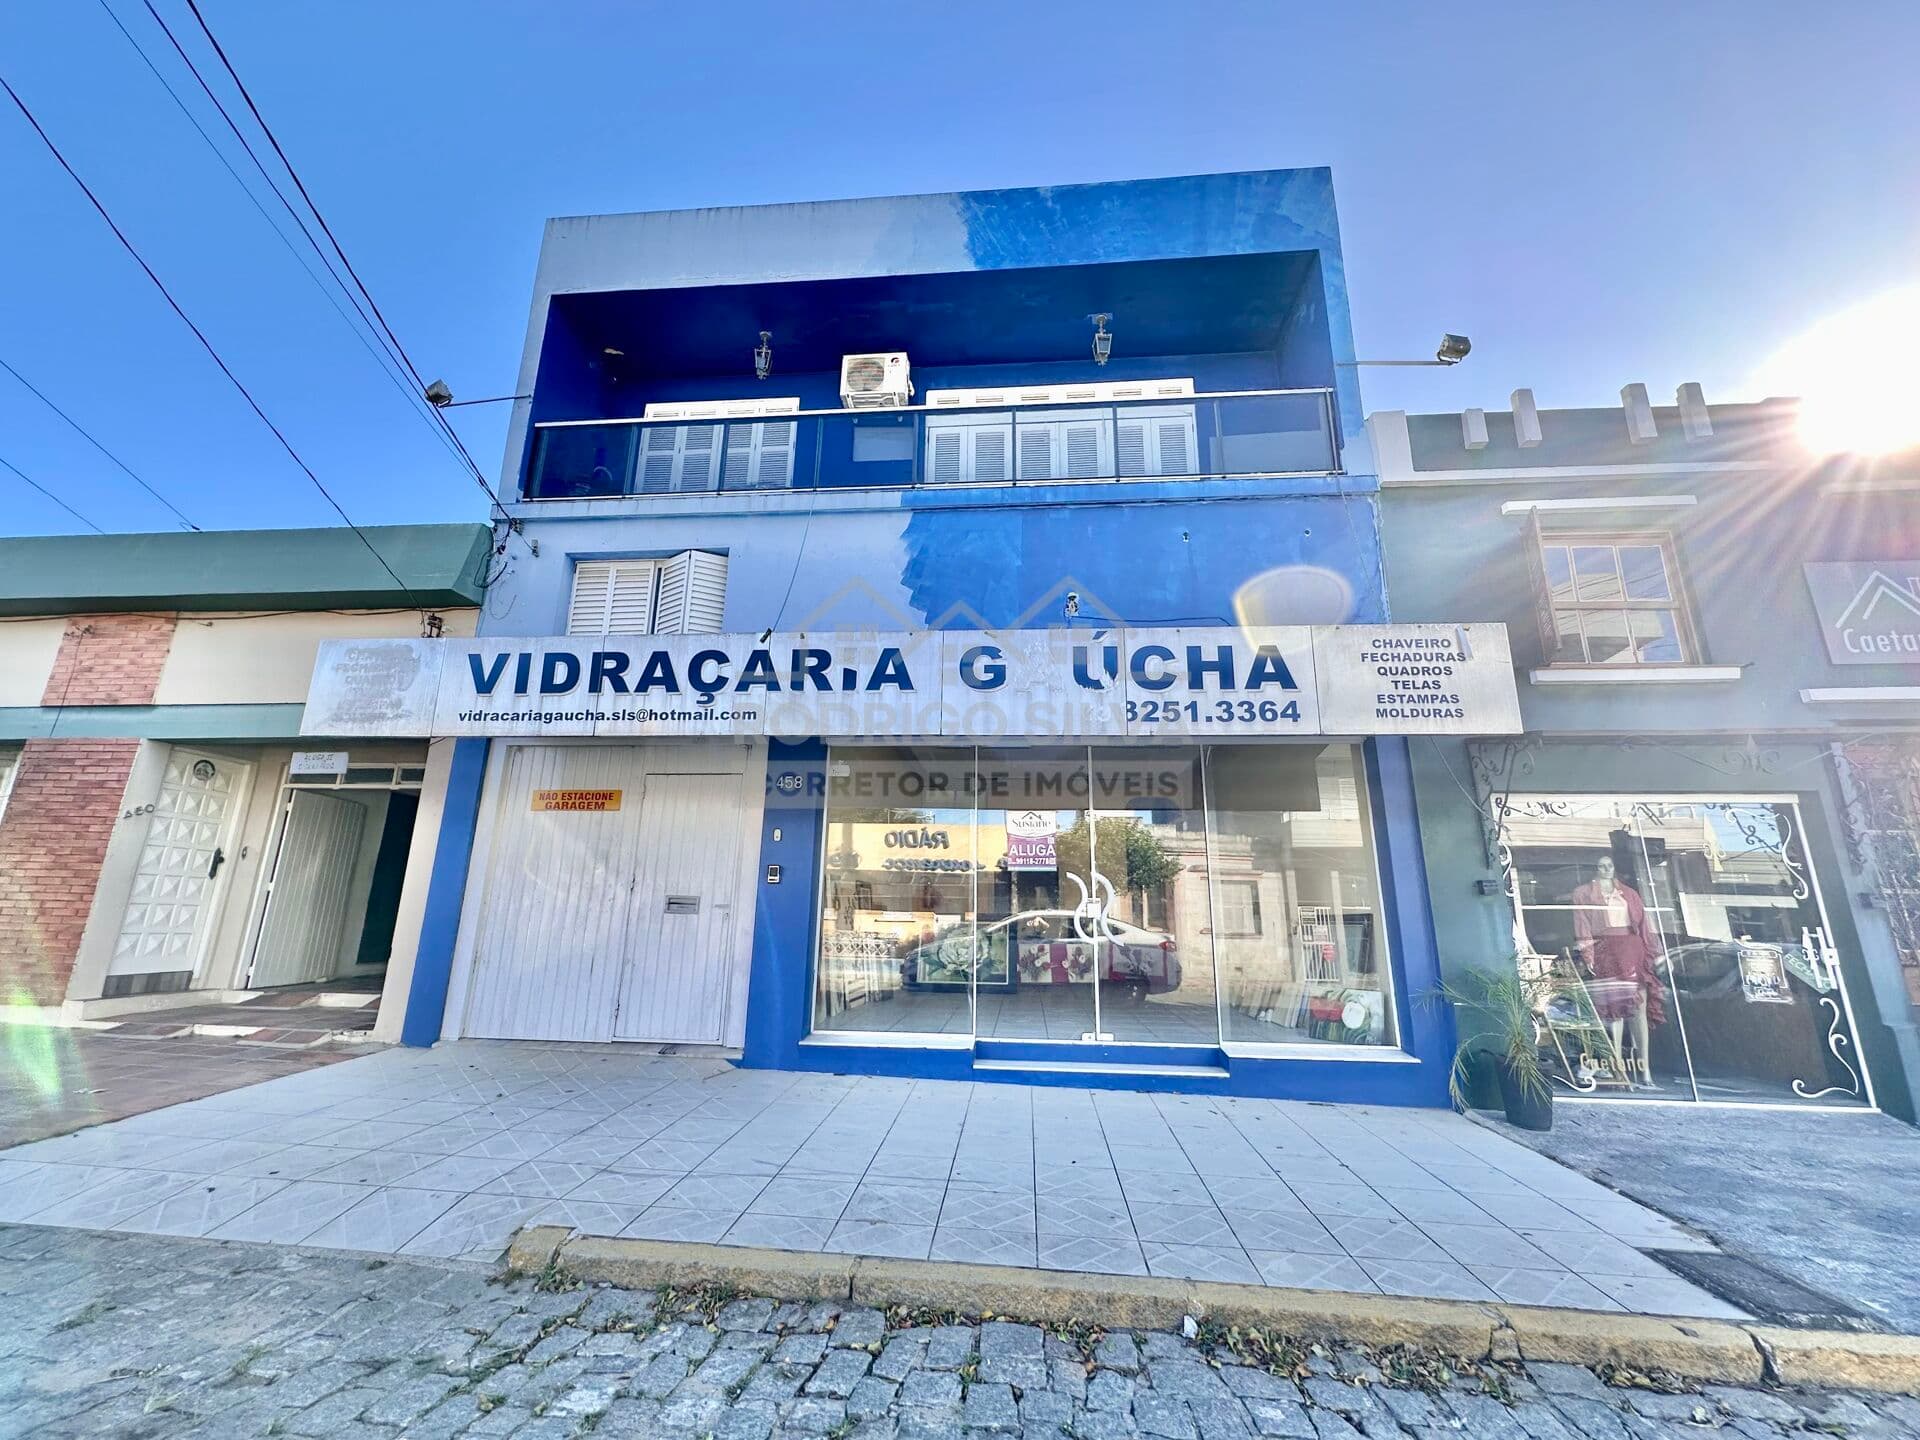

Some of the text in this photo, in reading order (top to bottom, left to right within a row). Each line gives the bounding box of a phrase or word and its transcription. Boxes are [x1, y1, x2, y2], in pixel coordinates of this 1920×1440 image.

[1371, 638, 1452, 649] CHAVEIRO
[1843, 627, 1920, 654] Caeta
[1360, 652, 1467, 663] FECHADURAS
[1376, 666, 1453, 676] QUADROS
[1391, 680, 1442, 690] TELAS
[1376, 694, 1460, 704] ESTAMPAS
[458, 707, 758, 724] vidracariagaucha.sls@hotmail.com
[1375, 708, 1465, 718] MOLDURAS
[775, 776, 803, 789] 458
[539, 791, 614, 801] NÃO ESTACIONE
[545, 801, 606, 810] GARAGEM
[1009, 844, 1056, 857] ALUGA
